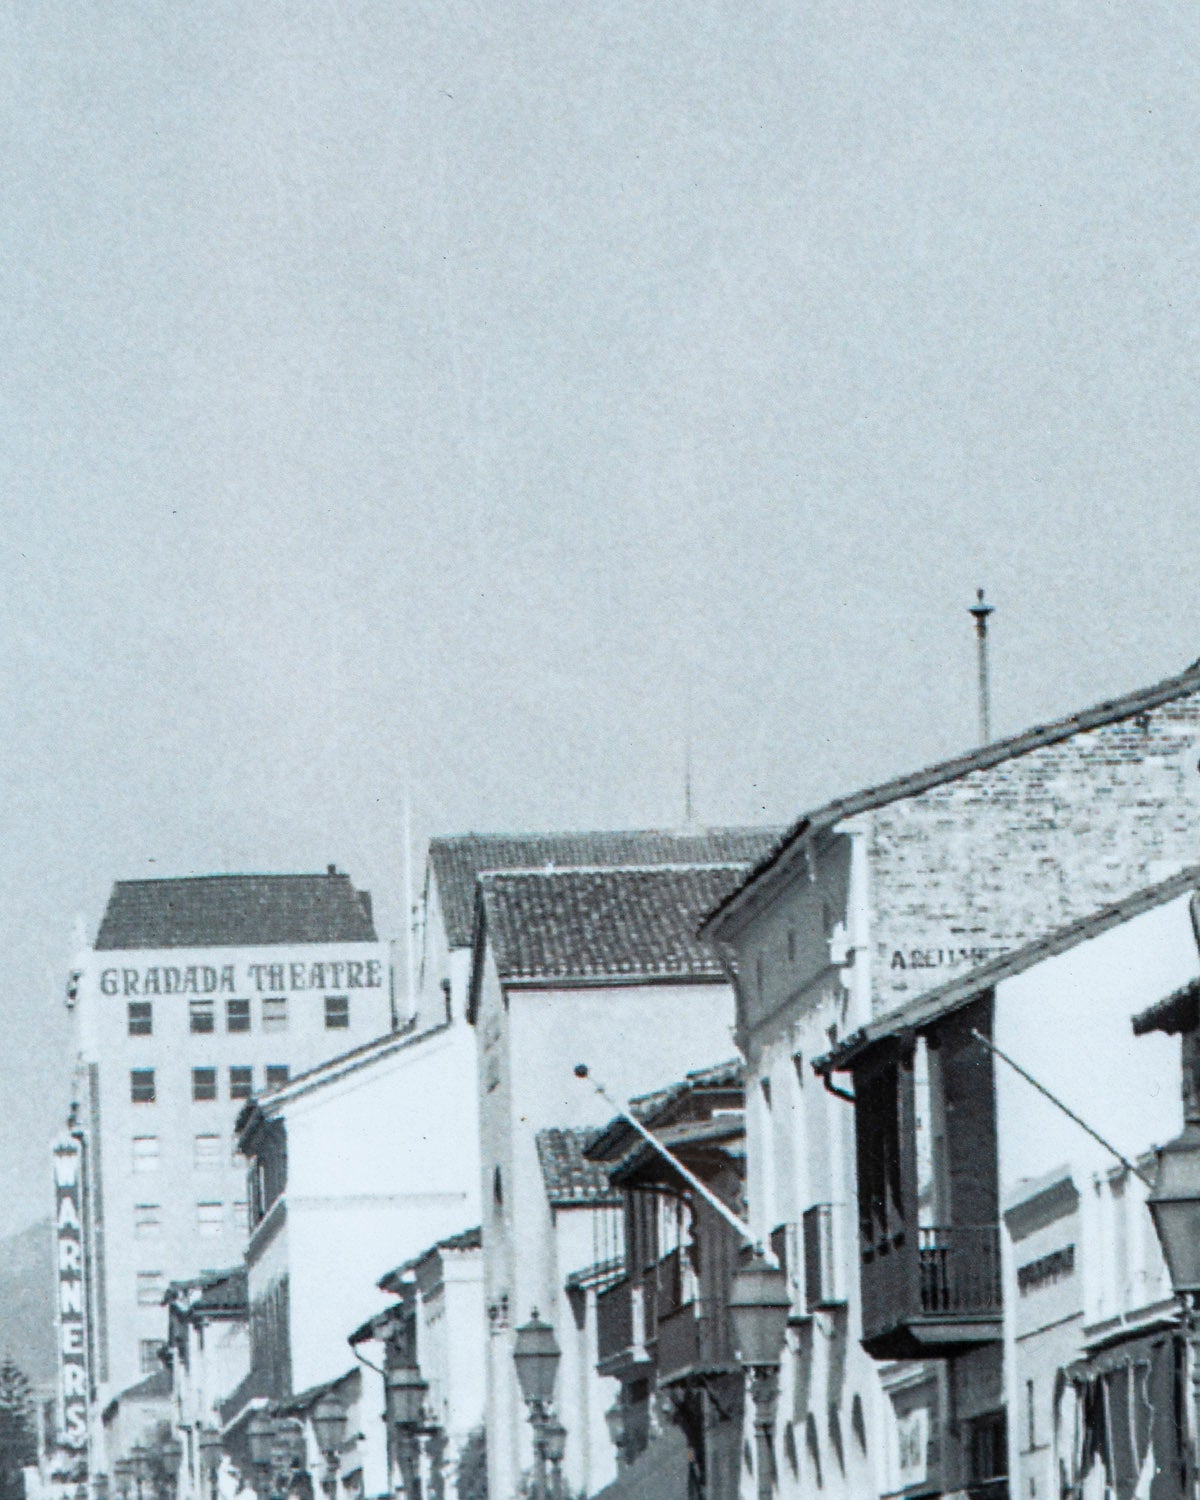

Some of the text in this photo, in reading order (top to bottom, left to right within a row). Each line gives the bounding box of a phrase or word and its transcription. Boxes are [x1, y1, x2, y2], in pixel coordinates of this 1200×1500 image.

[99, 958, 383, 997] GRANADA THEATRE
[53, 1150, 87, 1440] WARNERS
